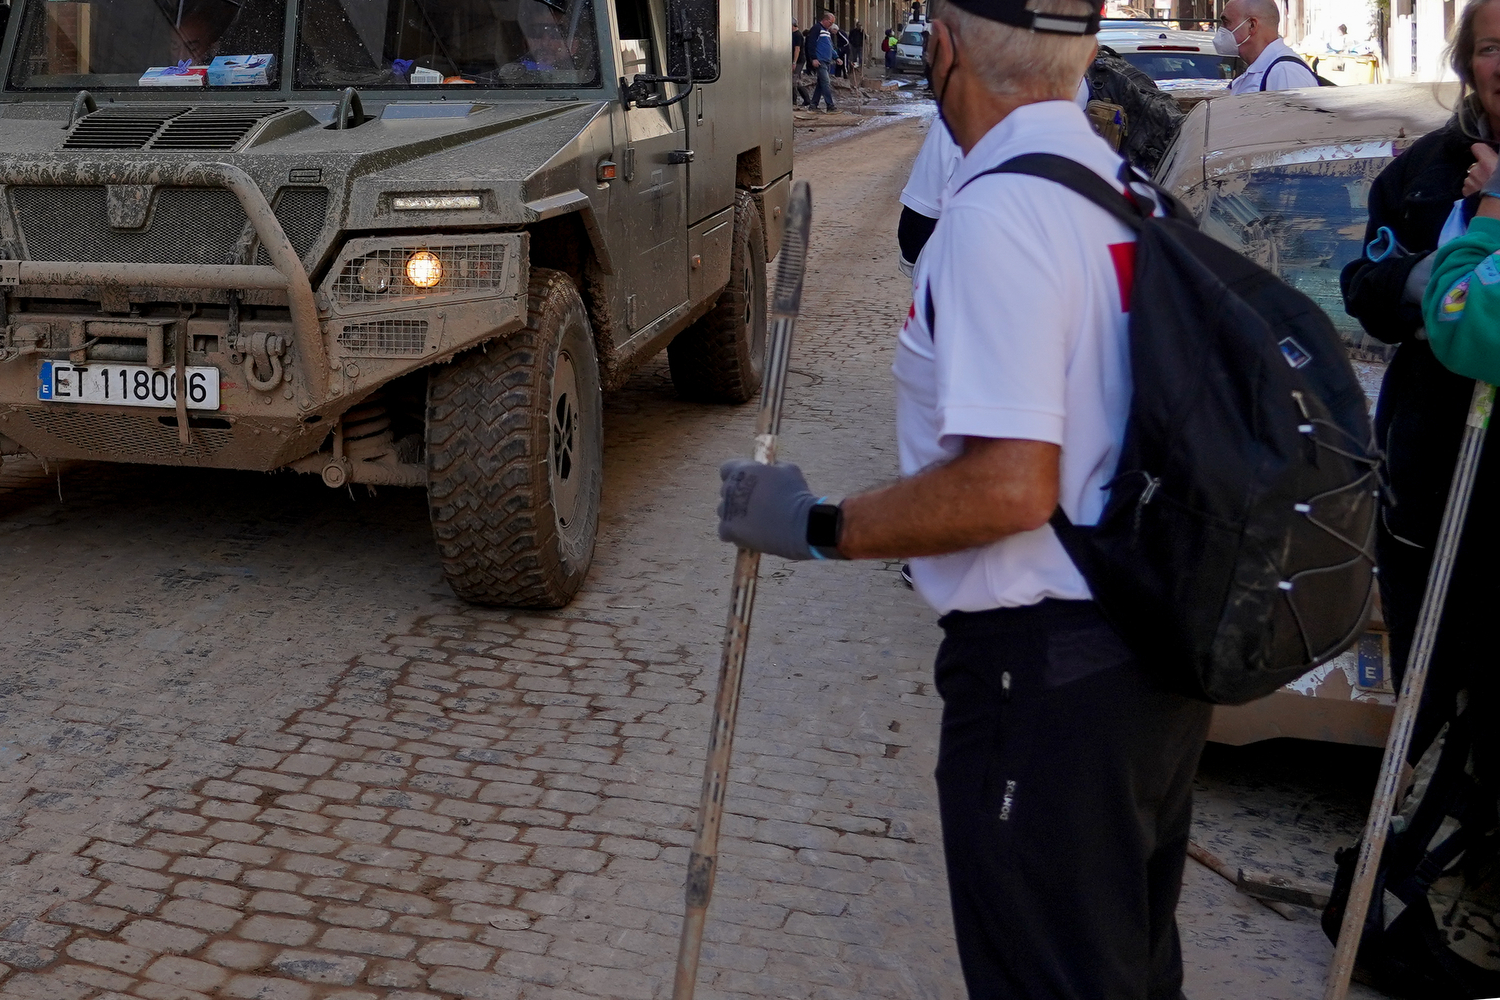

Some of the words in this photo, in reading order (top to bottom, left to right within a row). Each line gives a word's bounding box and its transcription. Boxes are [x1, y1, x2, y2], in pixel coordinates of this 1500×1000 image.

[54, 366, 88, 397] ET
[42, 384, 49, 393] E
[1365, 666, 1377, 679] E
